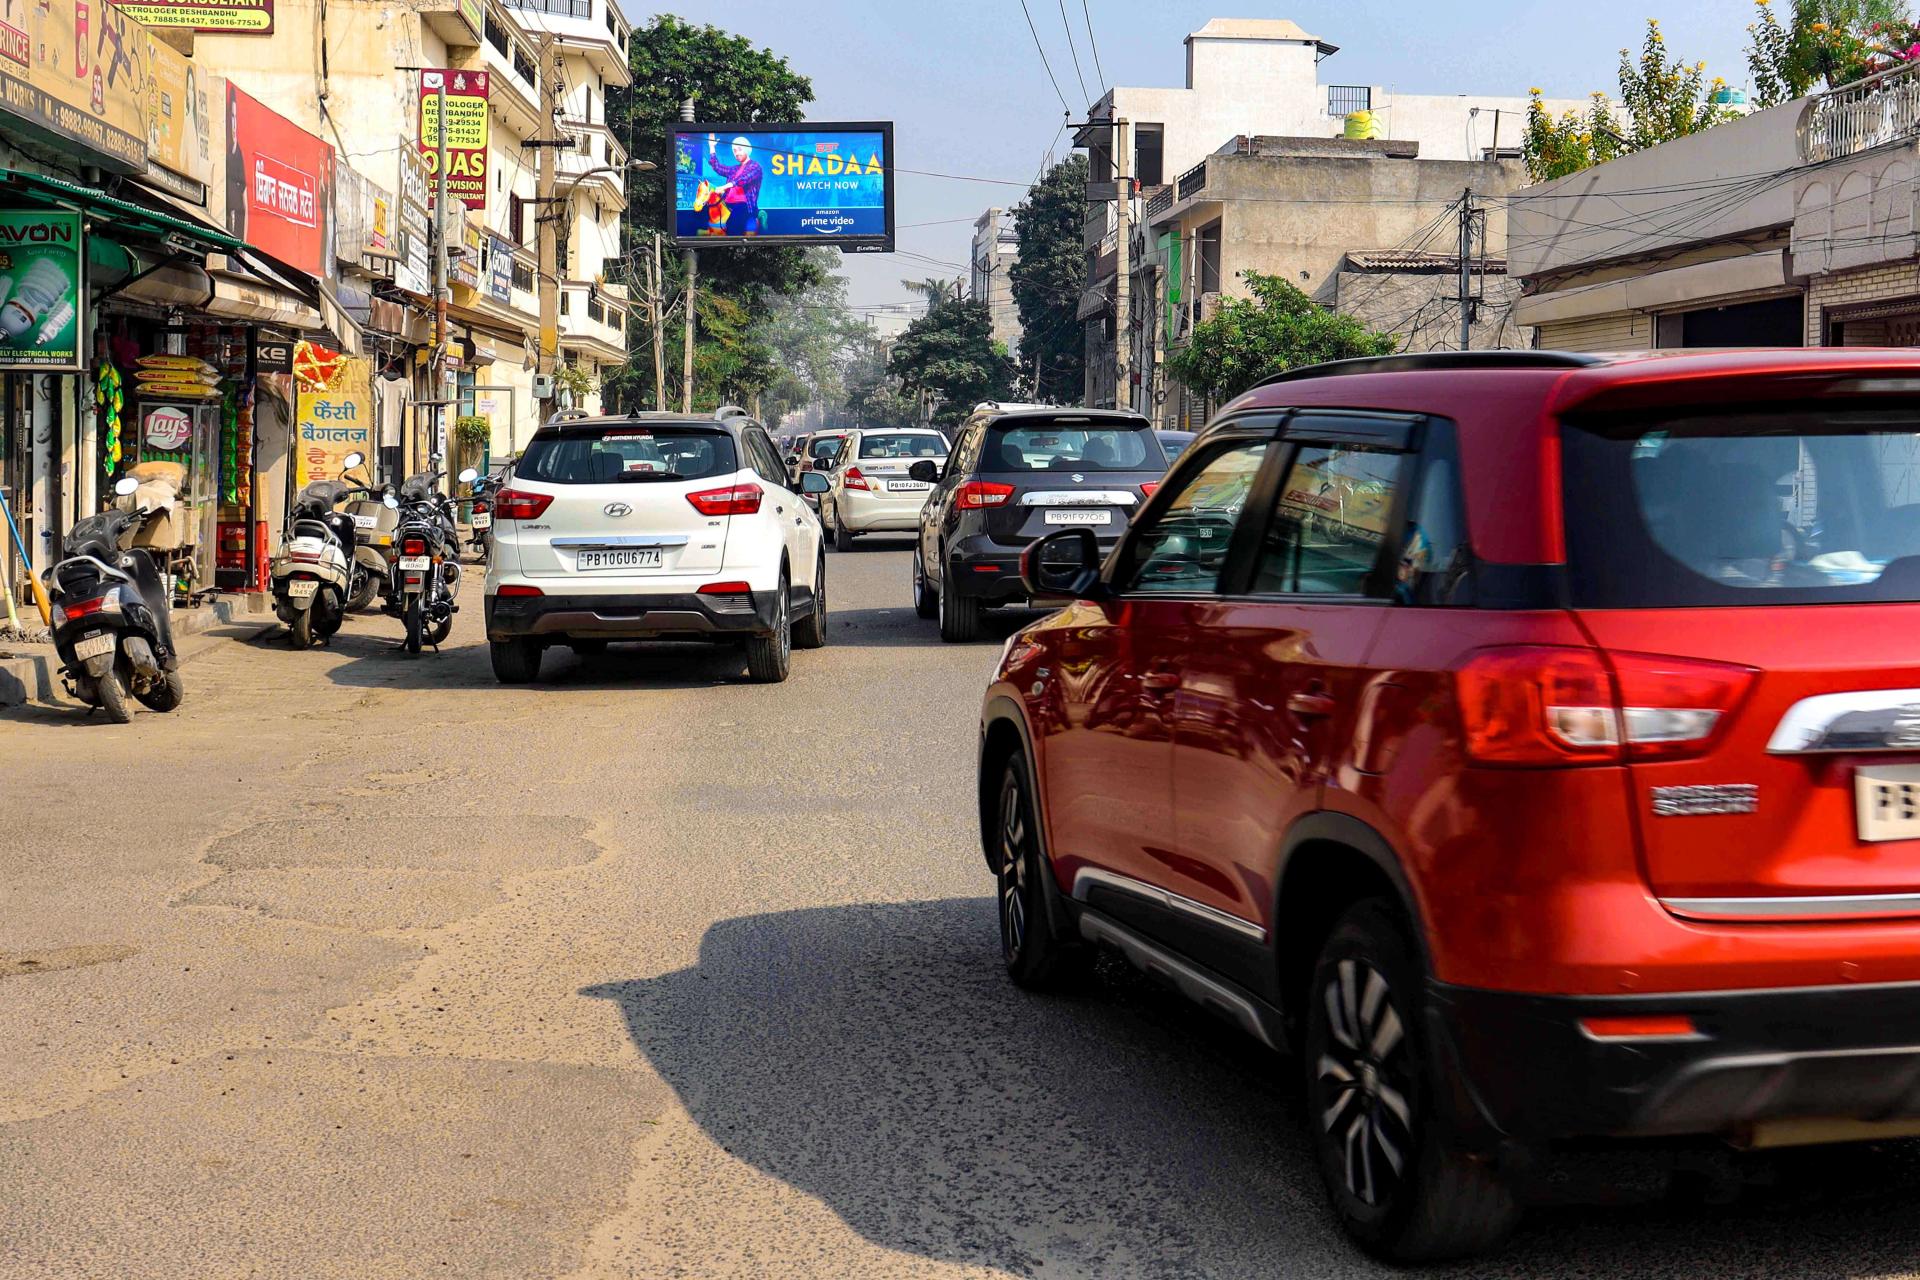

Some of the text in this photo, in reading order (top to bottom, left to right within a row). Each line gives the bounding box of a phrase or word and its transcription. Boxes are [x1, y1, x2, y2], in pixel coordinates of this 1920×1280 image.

[121, 5, 238, 16] ASTROLOGER DESHBANDHU
[5, 78, 35, 111] WORKS
[426, 99, 484, 109] ASROLOGER
[425, 109, 485, 118] DEBANDHU
[427, 117, 481, 127] 939-29534
[427, 126, 481, 135] 785-81437
[427, 134, 481, 143] 956-77534
[421, 150, 485, 177] OJAS
[771, 153, 884, 176] SHADAA
[428, 179, 483, 191] STOVISION
[796, 181, 859, 190] WATCH NOW
[801, 216, 854, 227] prime video
[11, 350, 50, 358] ELECTRICAL
[50, 350, 74, 358] WORKS
[586, 551, 660, 567] PB10GU6774
